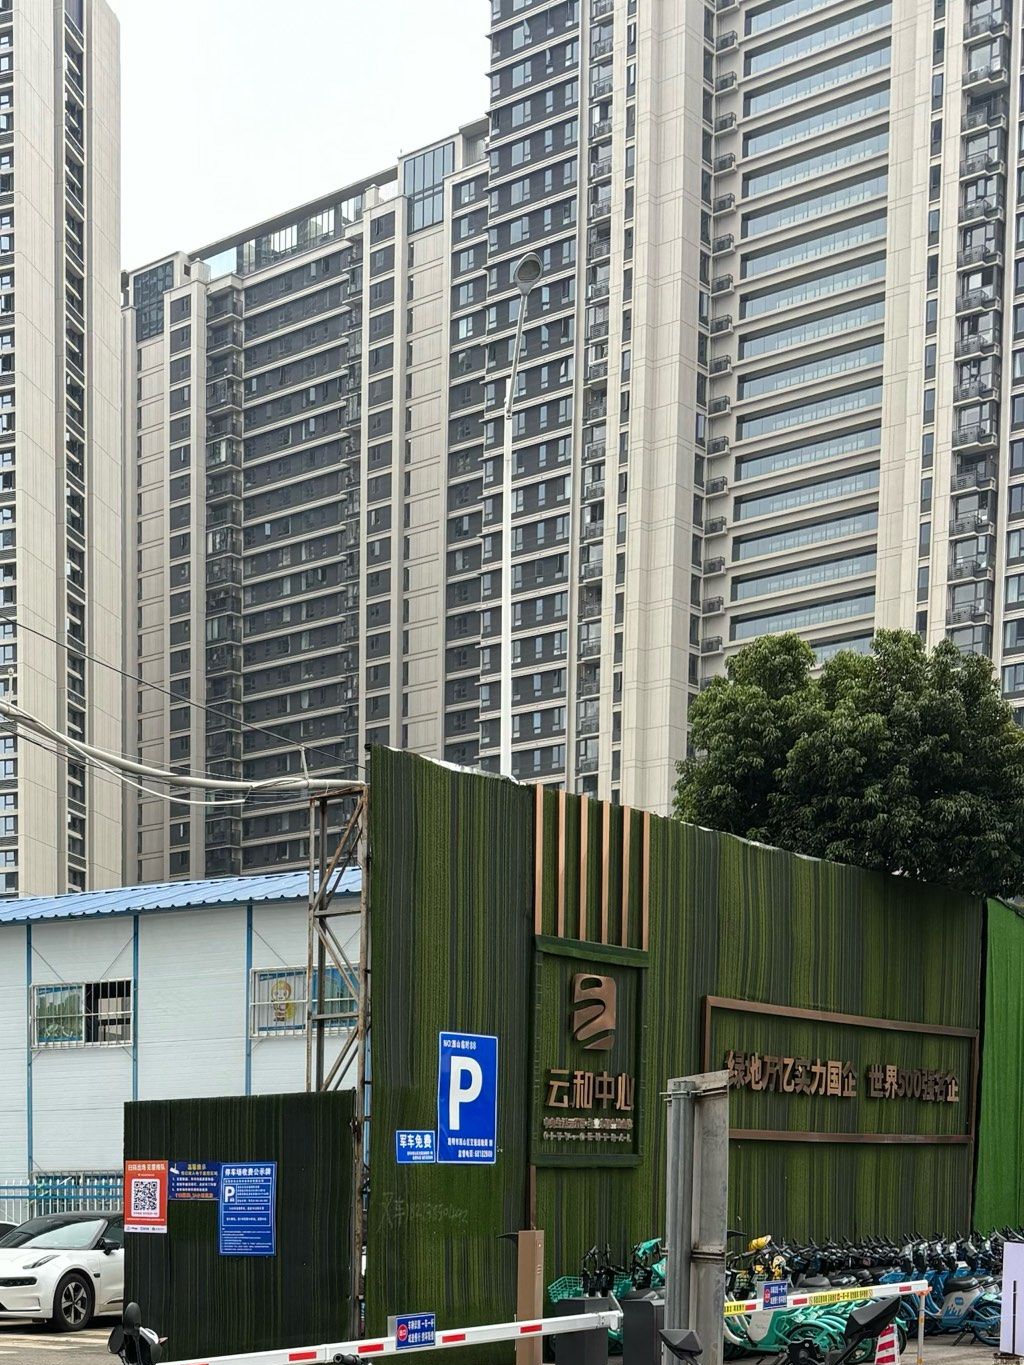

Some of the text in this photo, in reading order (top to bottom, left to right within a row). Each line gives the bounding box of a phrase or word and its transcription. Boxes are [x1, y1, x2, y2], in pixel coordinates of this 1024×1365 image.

[449, 1055, 483, 1130] P
[547, 1069, 635, 1111] 云和中心
[399, 1133, 432, 1149] 军车免费
[224, 1185, 236, 1203] P
